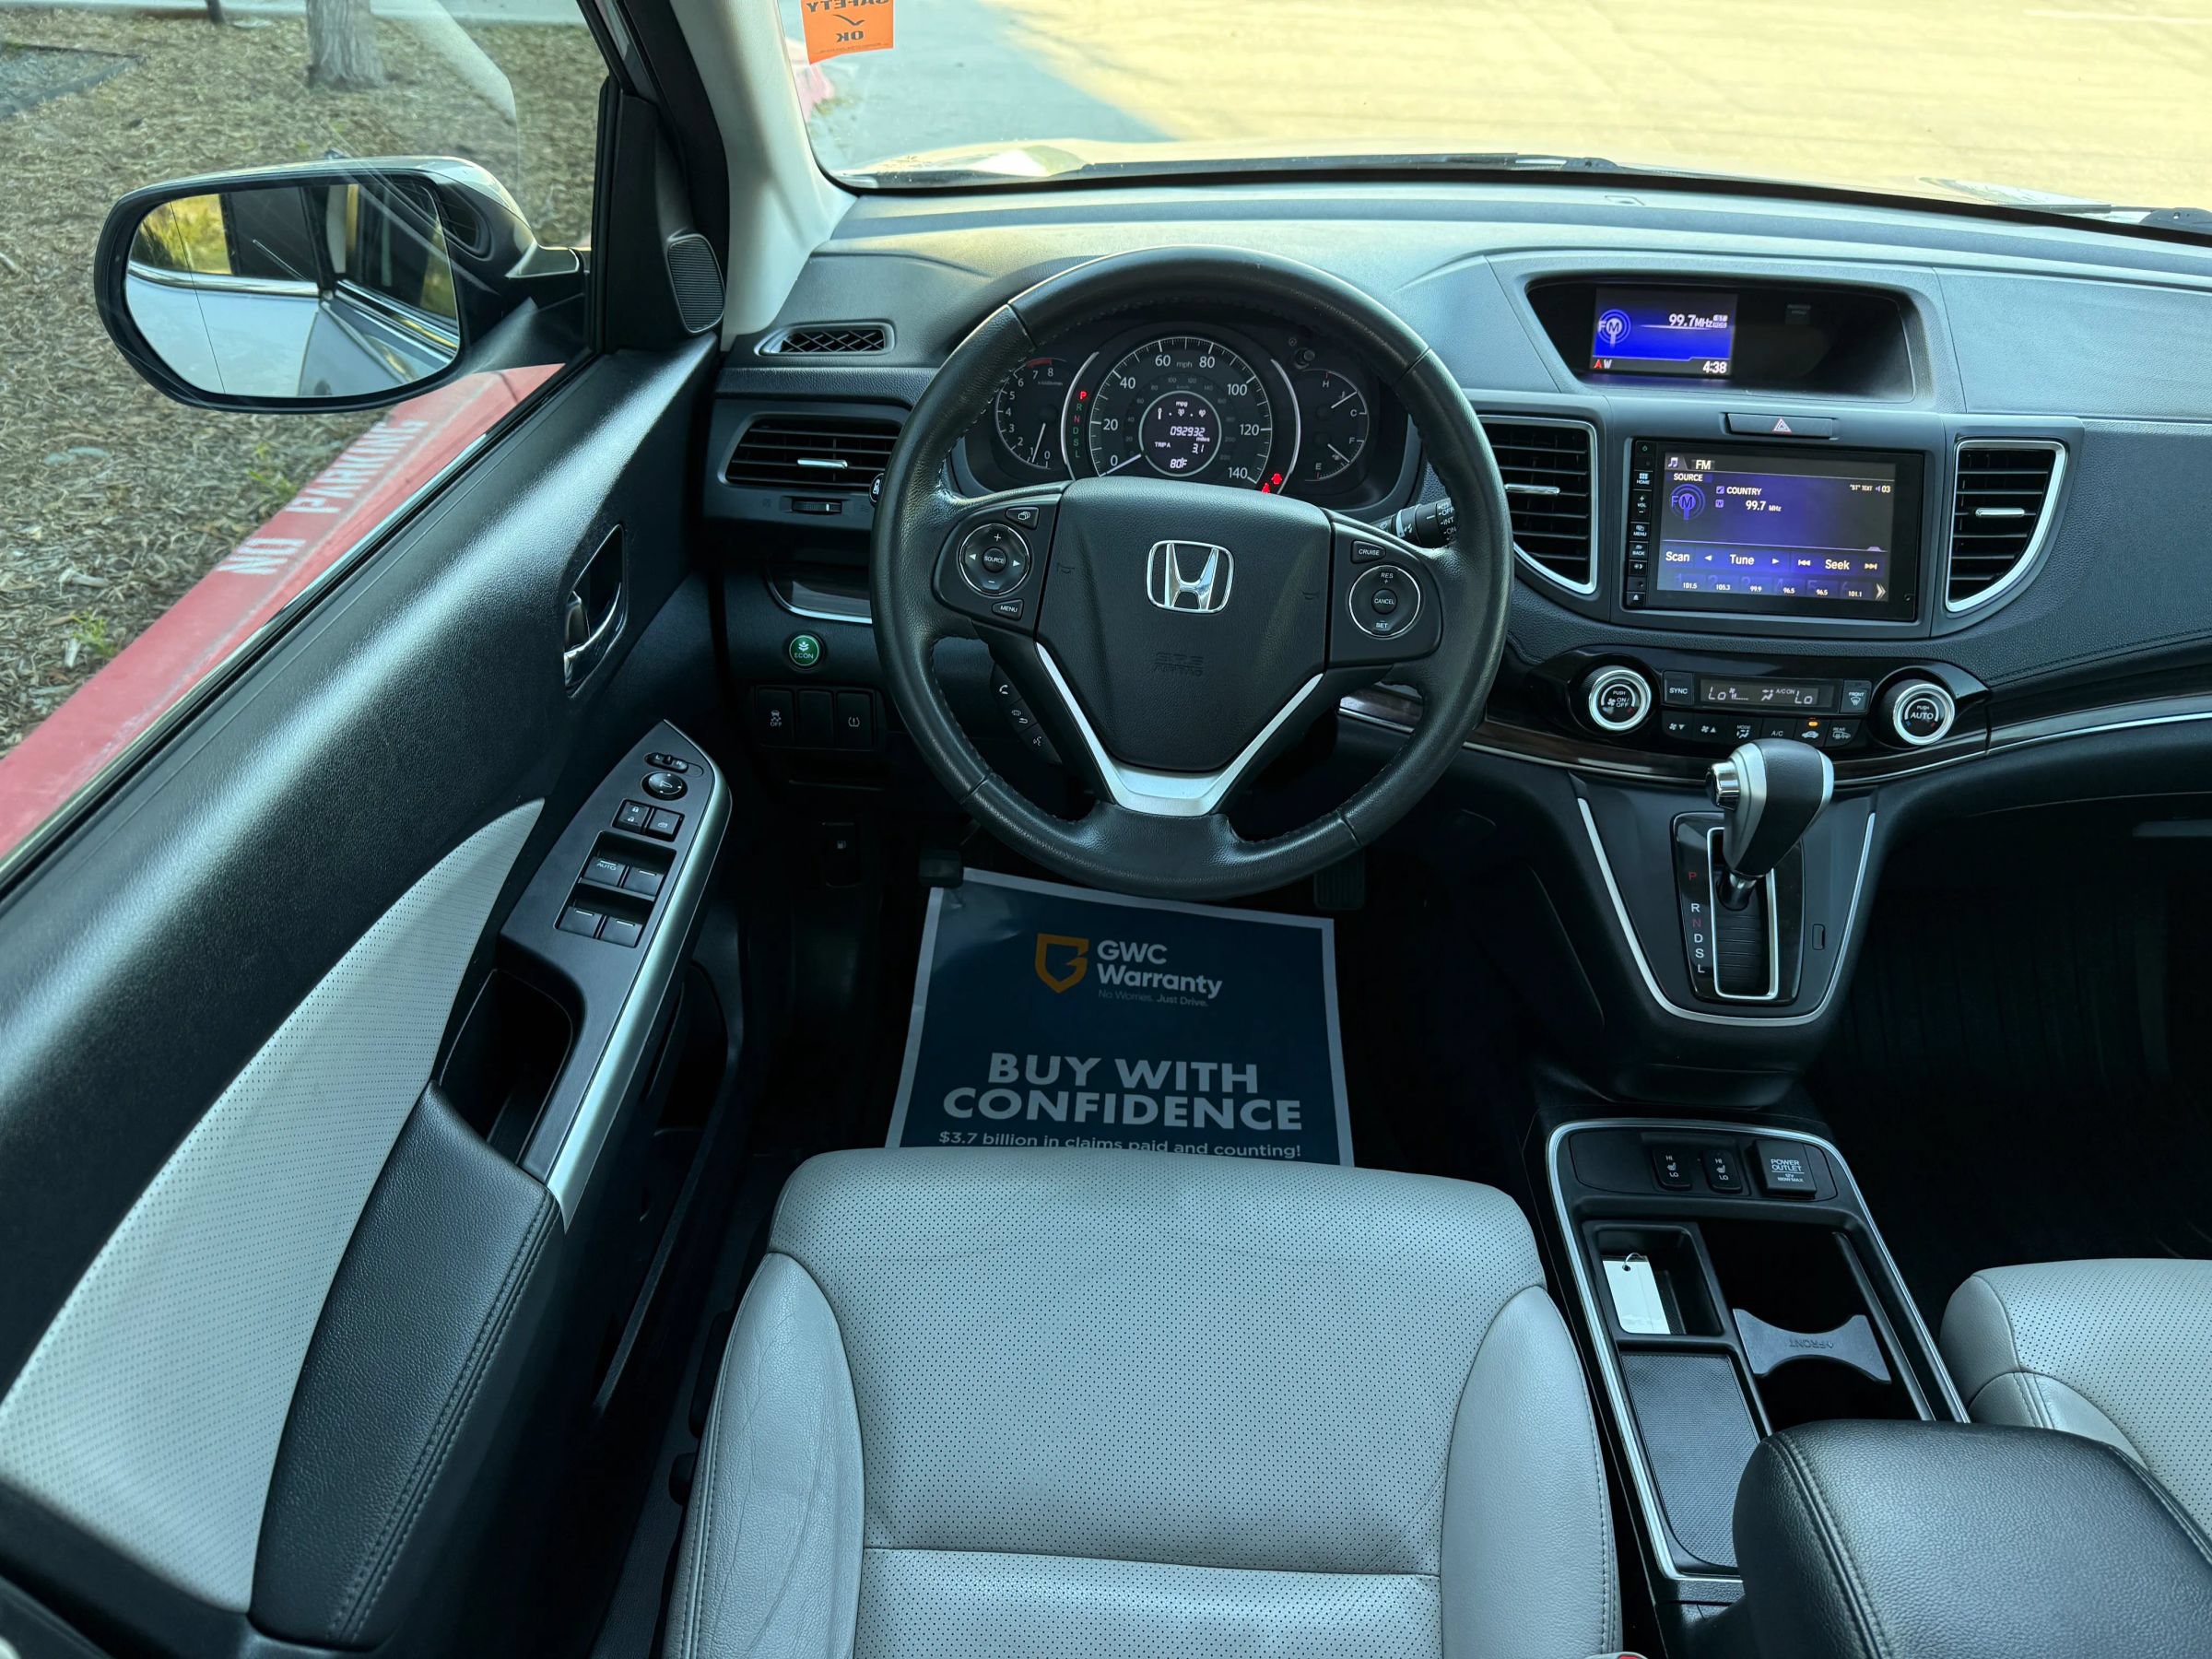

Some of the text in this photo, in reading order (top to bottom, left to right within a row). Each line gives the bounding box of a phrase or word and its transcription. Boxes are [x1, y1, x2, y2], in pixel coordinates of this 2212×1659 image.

[1155, 354, 1171, 367] 60
[1199, 356, 1216, 369] 80
[1702, 361, 1727, 373] 4:38
[1032, 371, 1039, 380] 7
[1047, 368, 1054, 377] 8
[1018, 379, 1024, 387] 6
[1120, 376, 1136, 389] 40
[1323, 380, 1329, 388] H
[1227, 383, 1248, 396] 100
[1009, 391, 1016, 400] 5
[1079, 391, 1088, 400] P
[1005, 407, 1012, 417] 4
[1350, 409, 1358, 418] C
[1009, 424, 1015, 433] 3
[1102, 418, 1119, 431] 20
[1072, 427, 1079, 435] D
[1170, 426, 1206, 437] 092932
[1240, 424, 1260, 436] 120
[1017, 437, 1024, 446] 2
[1043, 451, 1051, 460] 0
[1075, 450, 1080, 458] L
[1110, 454, 1118, 466] 0
[1696, 460, 1712, 470] FM
[1228, 466, 1248, 479] 140
[1674, 473, 1703, 482] SOURCE
[1726, 487, 1762, 496] COUNTRY
[216, 419, 429, 575] NO PARKING
[1671, 496, 1693, 509] FM
[1746, 500, 1766, 511] 99.7
[983, 555, 1004, 564] SOURCE
[1665, 551, 1690, 562] Scan
[1730, 554, 1755, 565] Tune
[1825, 559, 1850, 570] Seek
[1000, 605, 1018, 613] MENU
[1910, 712, 1934, 720] AUTO
[1688, 872, 1697, 880] P
[1691, 903, 1700, 912] R
[1692, 918, 1701, 927] N
[1694, 934, 1703, 943] D
[1097, 940, 1168, 965] GWC
[1695, 948, 1704, 959] S
[1698, 964, 1705, 973] L
[1097, 963, 1223, 999] Warranty
[1157, 995, 1178, 1004] Just
[988, 1053, 1258, 1094] BUY WITH
[943, 1087, 1302, 1131] CONFIDENCE
[938, 1131, 1301, 1159] $3.7 billion in claims paid and counting!
